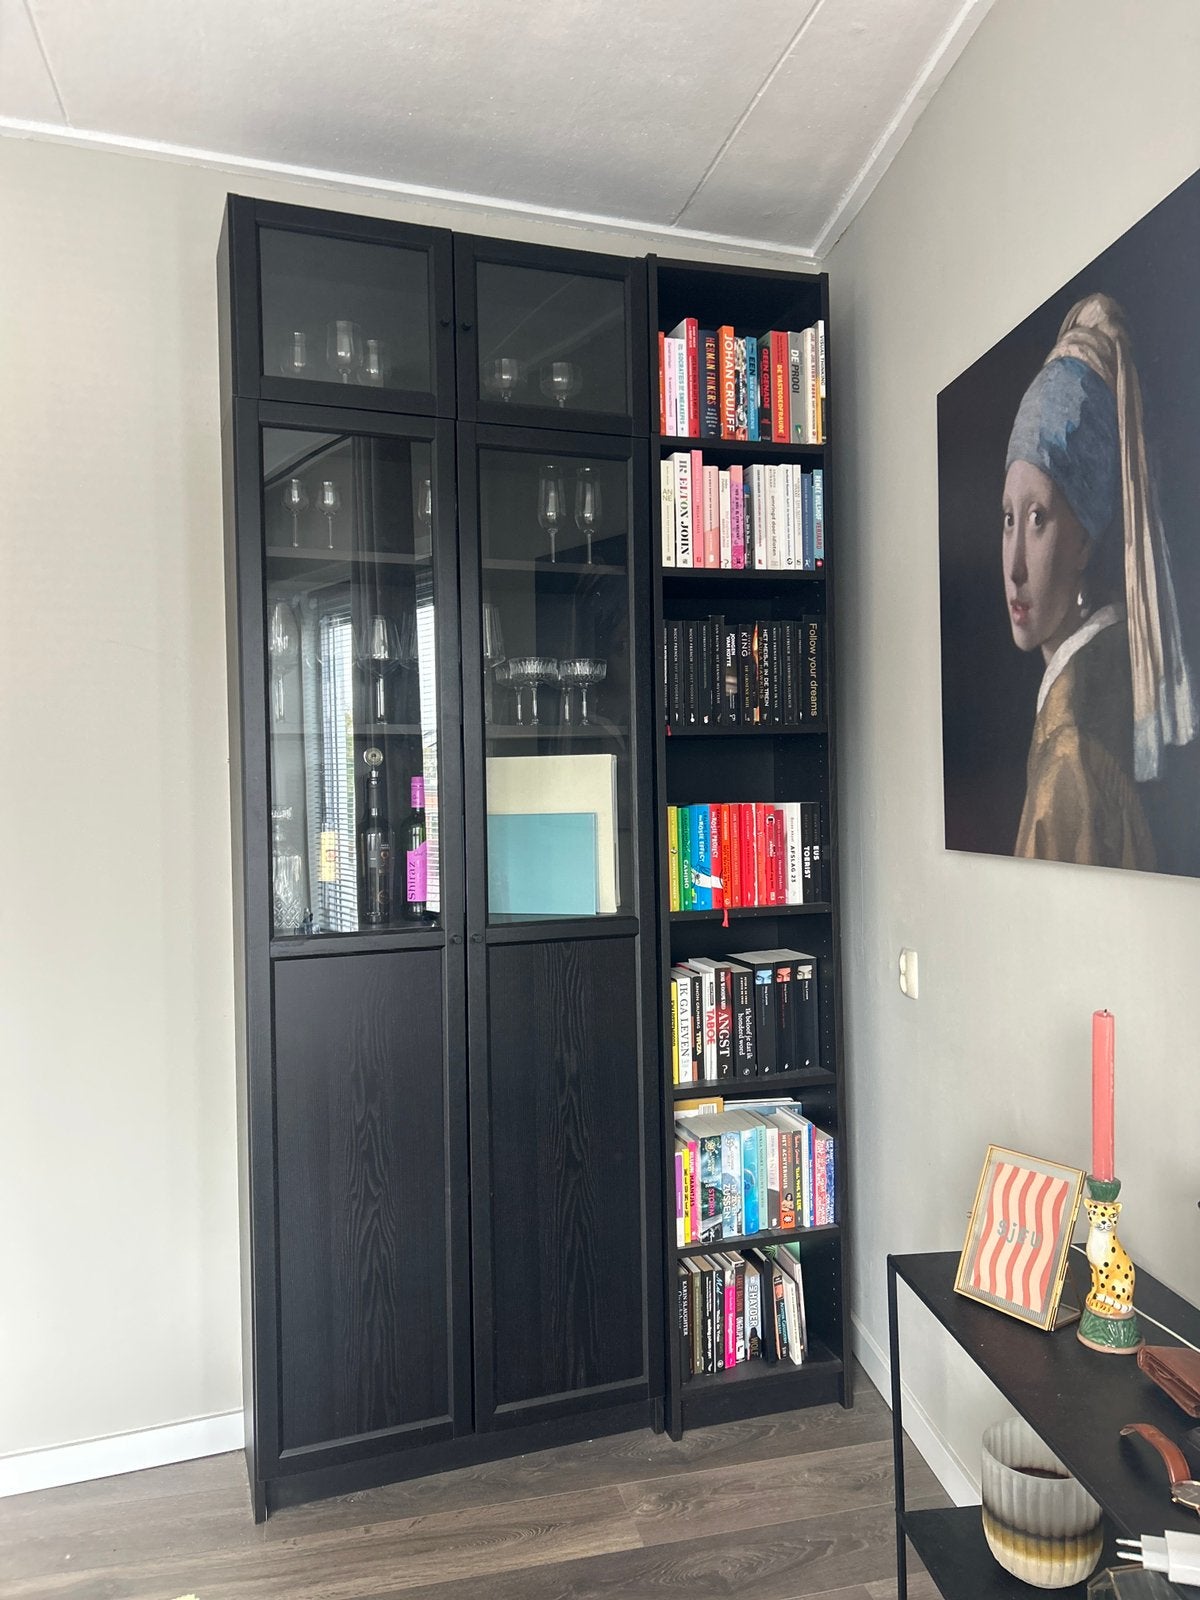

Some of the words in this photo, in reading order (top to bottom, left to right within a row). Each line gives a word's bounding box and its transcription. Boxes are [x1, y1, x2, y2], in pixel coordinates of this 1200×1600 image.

[705, 337, 716, 370] HERMAN
[725, 334, 734, 378] JOHAN
[777, 364, 783, 373] DE
[791, 349, 799, 363] DE
[706, 372, 716, 405] FINKERS
[791, 364, 800, 393] PROOI
[726, 382, 735, 432] CRUIJFF
[679, 477, 688, 518] ELTON
[680, 521, 689, 555] JOHN
[764, 677, 769, 686] DE
[808, 657, 817, 677] your
[680, 983, 688, 996] IK
[680, 999, 688, 1015] GA
[681, 1018, 689, 1056] LEVEN
[706, 1008, 715, 1045] TABOE
[718, 1012, 730, 1057] ANGST
[731, 1184, 736, 1194] DE
[749, 1292, 758, 1327] HAYDER
